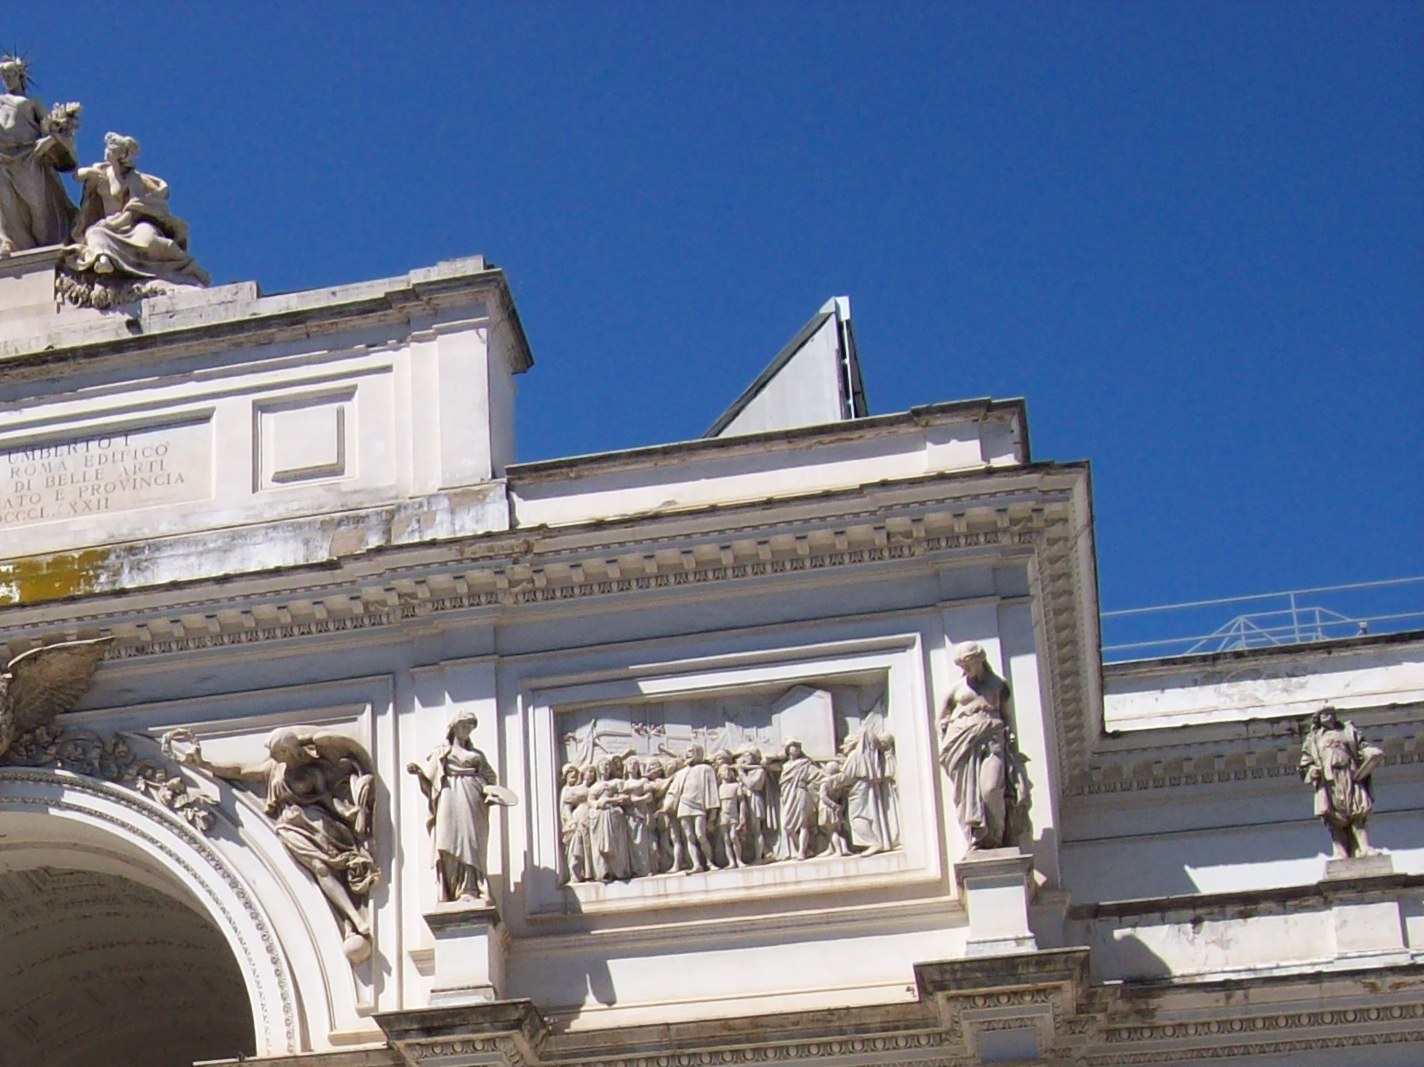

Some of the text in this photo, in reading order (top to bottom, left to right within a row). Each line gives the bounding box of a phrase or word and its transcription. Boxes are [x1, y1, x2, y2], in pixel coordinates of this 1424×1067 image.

[10, 459, 68, 479] ROMA
[14, 480, 32, 493] DI
[45, 468, 104, 489] BELLE
[120, 459, 165, 478] ARTI
[55, 489, 65, 502] E
[79, 472, 185, 499] PROVINCIA
